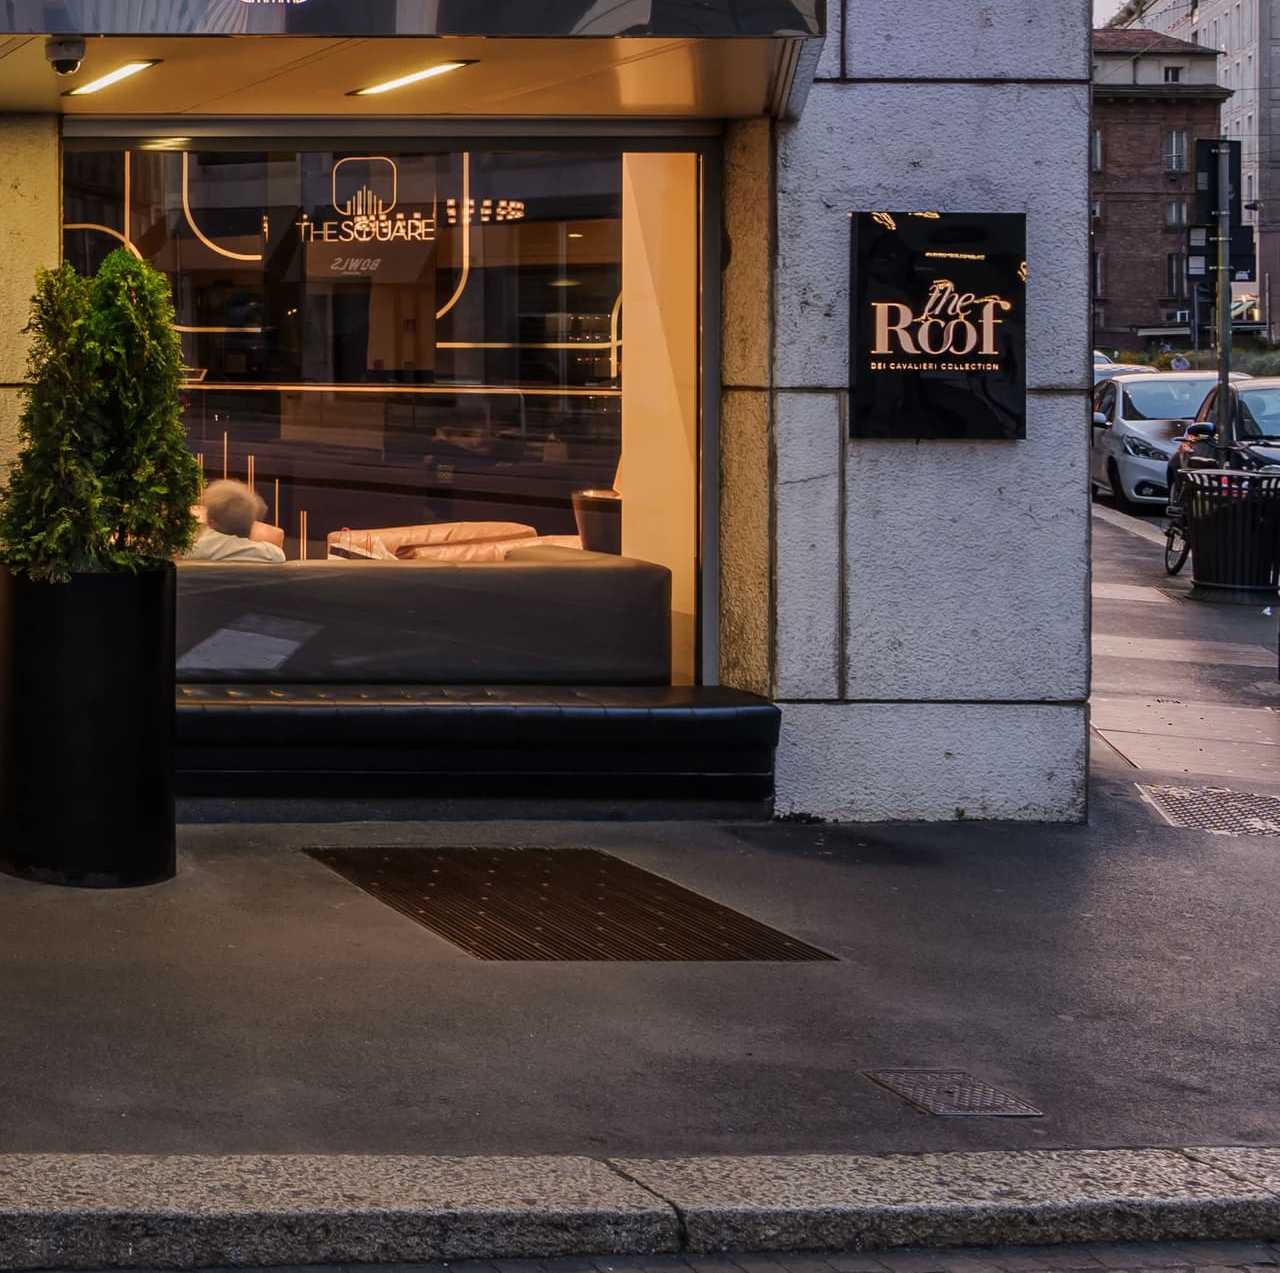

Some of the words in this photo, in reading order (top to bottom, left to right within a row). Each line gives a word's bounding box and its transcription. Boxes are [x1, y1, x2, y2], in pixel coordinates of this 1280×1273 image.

[295, 219, 436, 243] THESQUARE
[870, 361, 887, 371] DEI
[889, 362, 938, 371] CAVALIERI
[940, 362, 999, 371] COLLECTION
